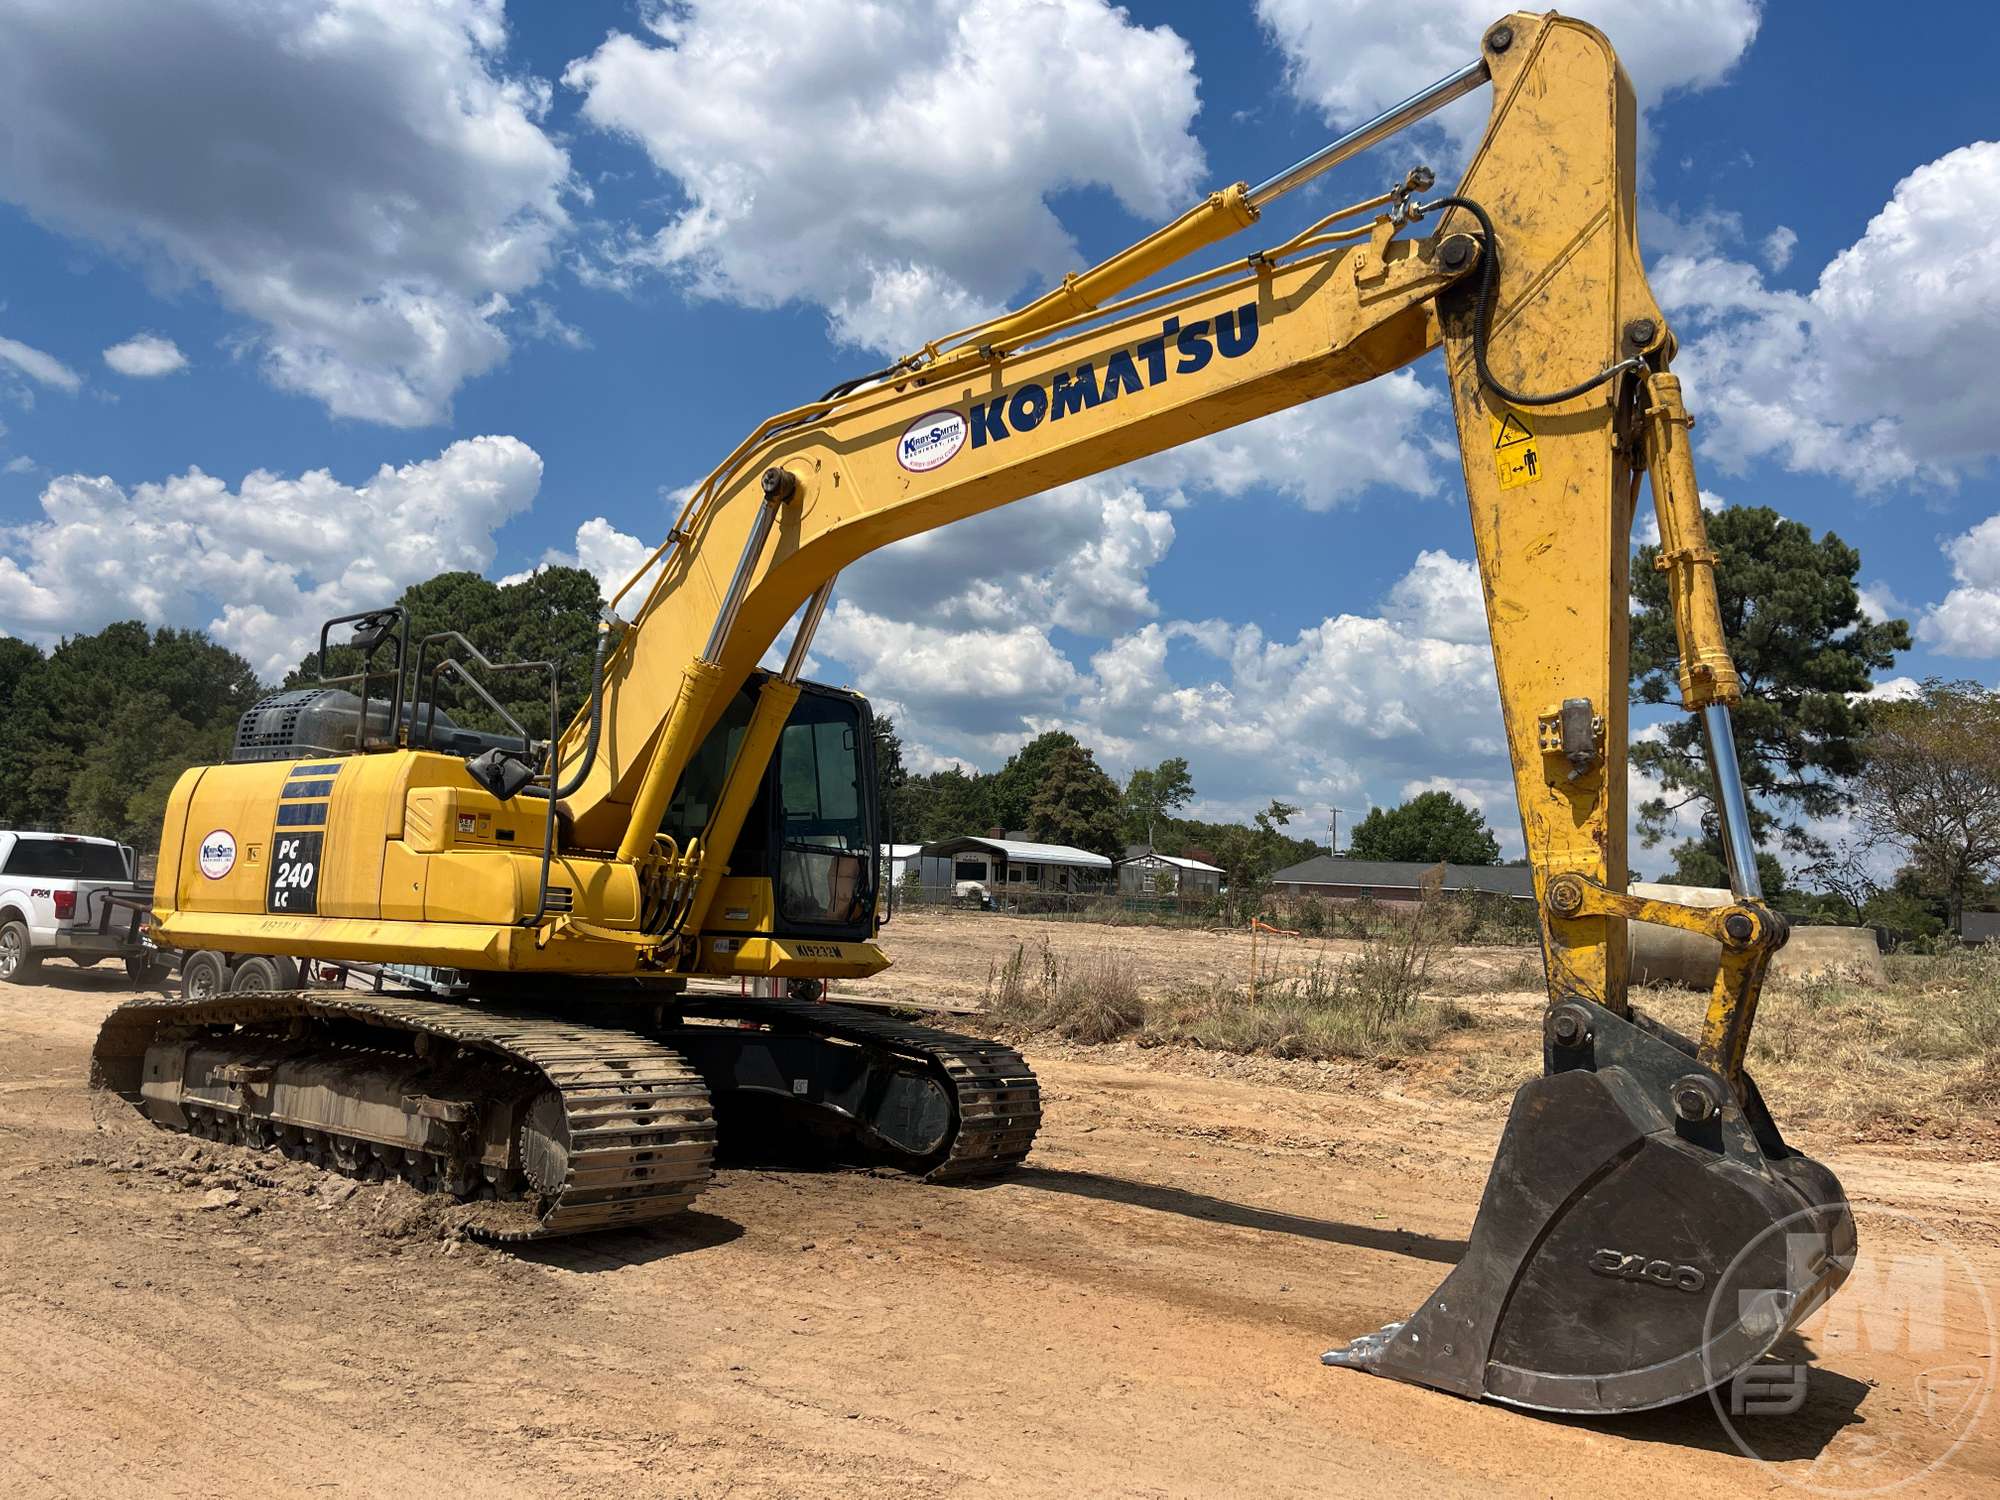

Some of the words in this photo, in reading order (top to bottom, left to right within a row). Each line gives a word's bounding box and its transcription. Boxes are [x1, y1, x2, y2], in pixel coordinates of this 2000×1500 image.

[970, 301, 1259, 449] KOMATSU
[279, 840, 300, 859] PC
[274, 862, 314, 889] 240
[274, 891, 289, 908] LC
